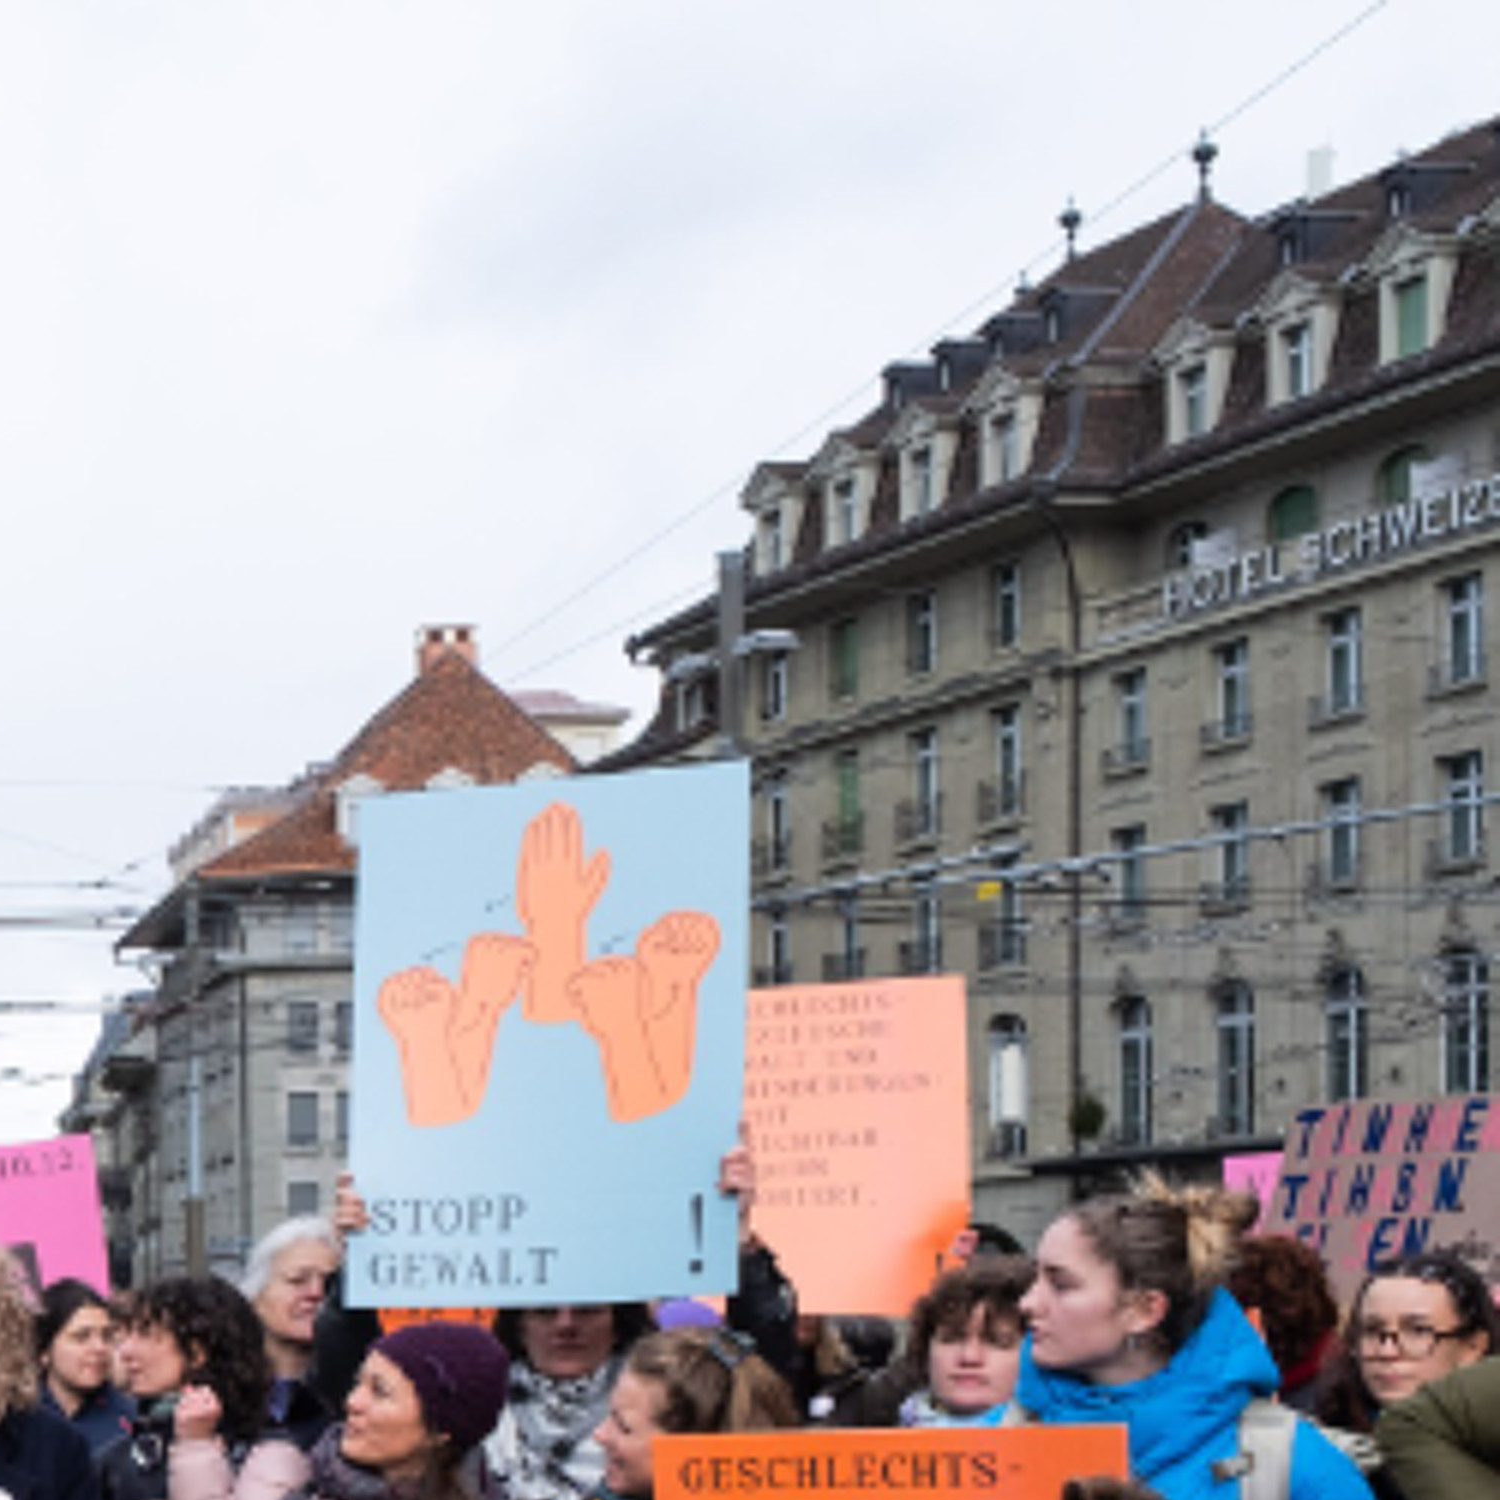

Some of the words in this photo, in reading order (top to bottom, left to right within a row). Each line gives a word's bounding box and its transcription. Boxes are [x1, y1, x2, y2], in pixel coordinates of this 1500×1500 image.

[1162, 545, 1284, 619] HOTEL
[369, 1196, 528, 1236] STOPP
[368, 1247, 559, 1288] GEWALT
[678, 1451, 1022, 1492] GESCHLECHTS-
